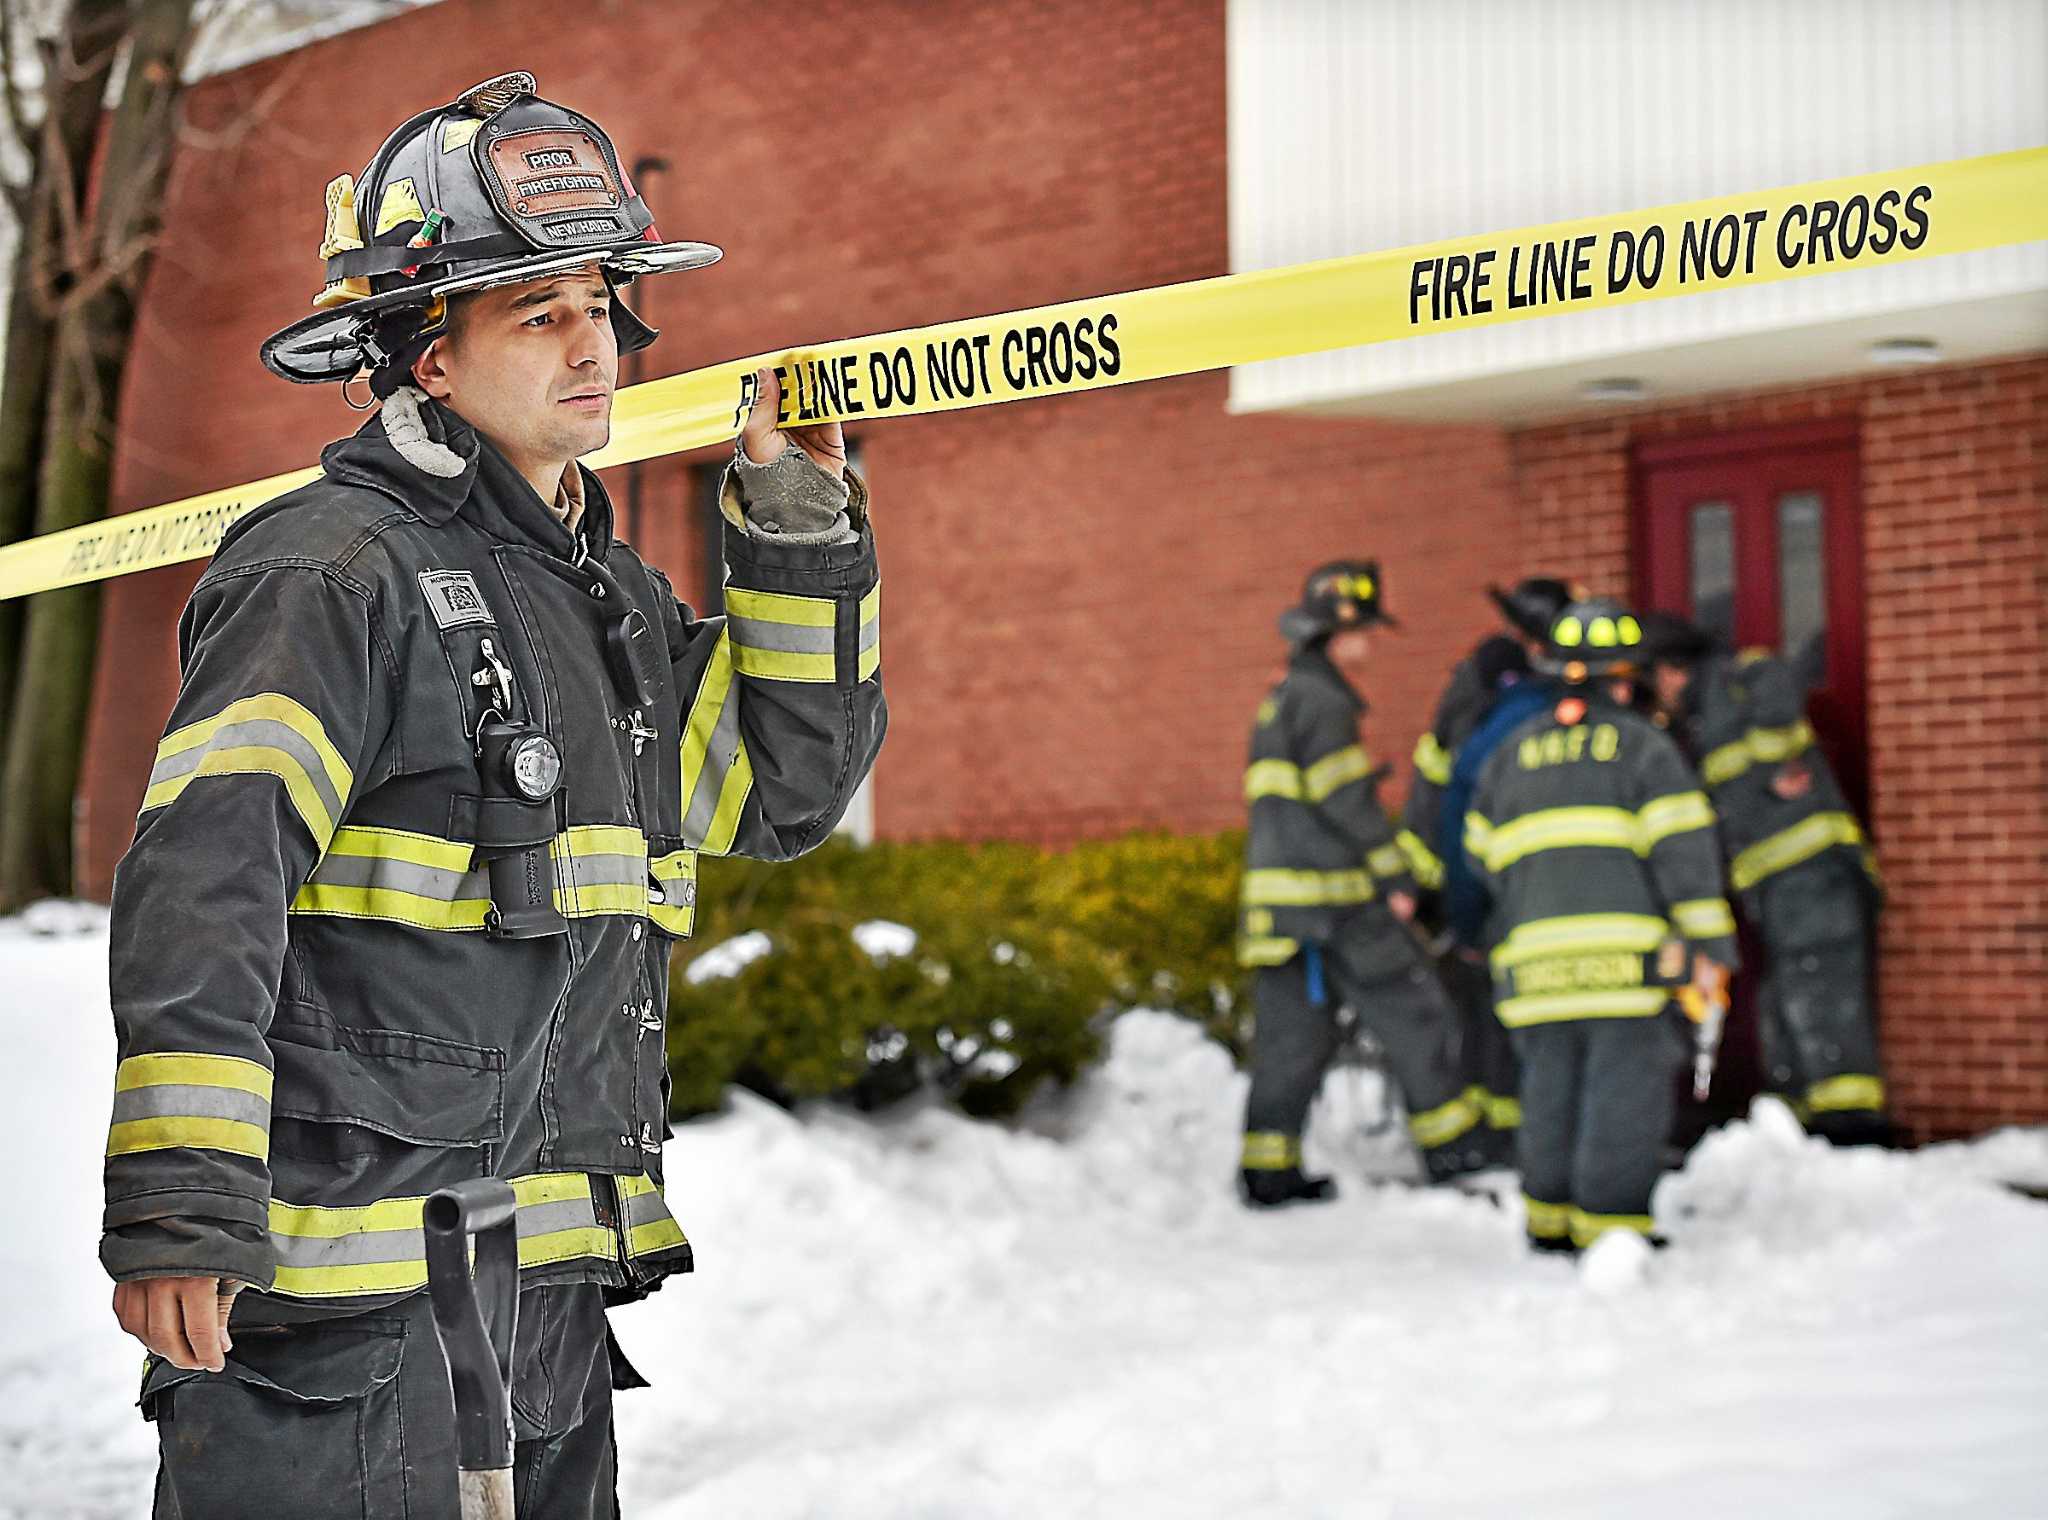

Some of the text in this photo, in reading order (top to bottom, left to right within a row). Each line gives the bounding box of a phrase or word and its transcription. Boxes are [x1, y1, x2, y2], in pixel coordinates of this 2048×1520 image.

[529, 153, 572, 168] PROB
[518, 176, 603, 196] FIREFIGHTER
[546, 219, 616, 239] NEW HAVEN
[1409, 185, 1932, 324] FIRE LINE DO NOT CROSS
[734, 313, 1121, 428] FIE LINE DO NOT CROSS
